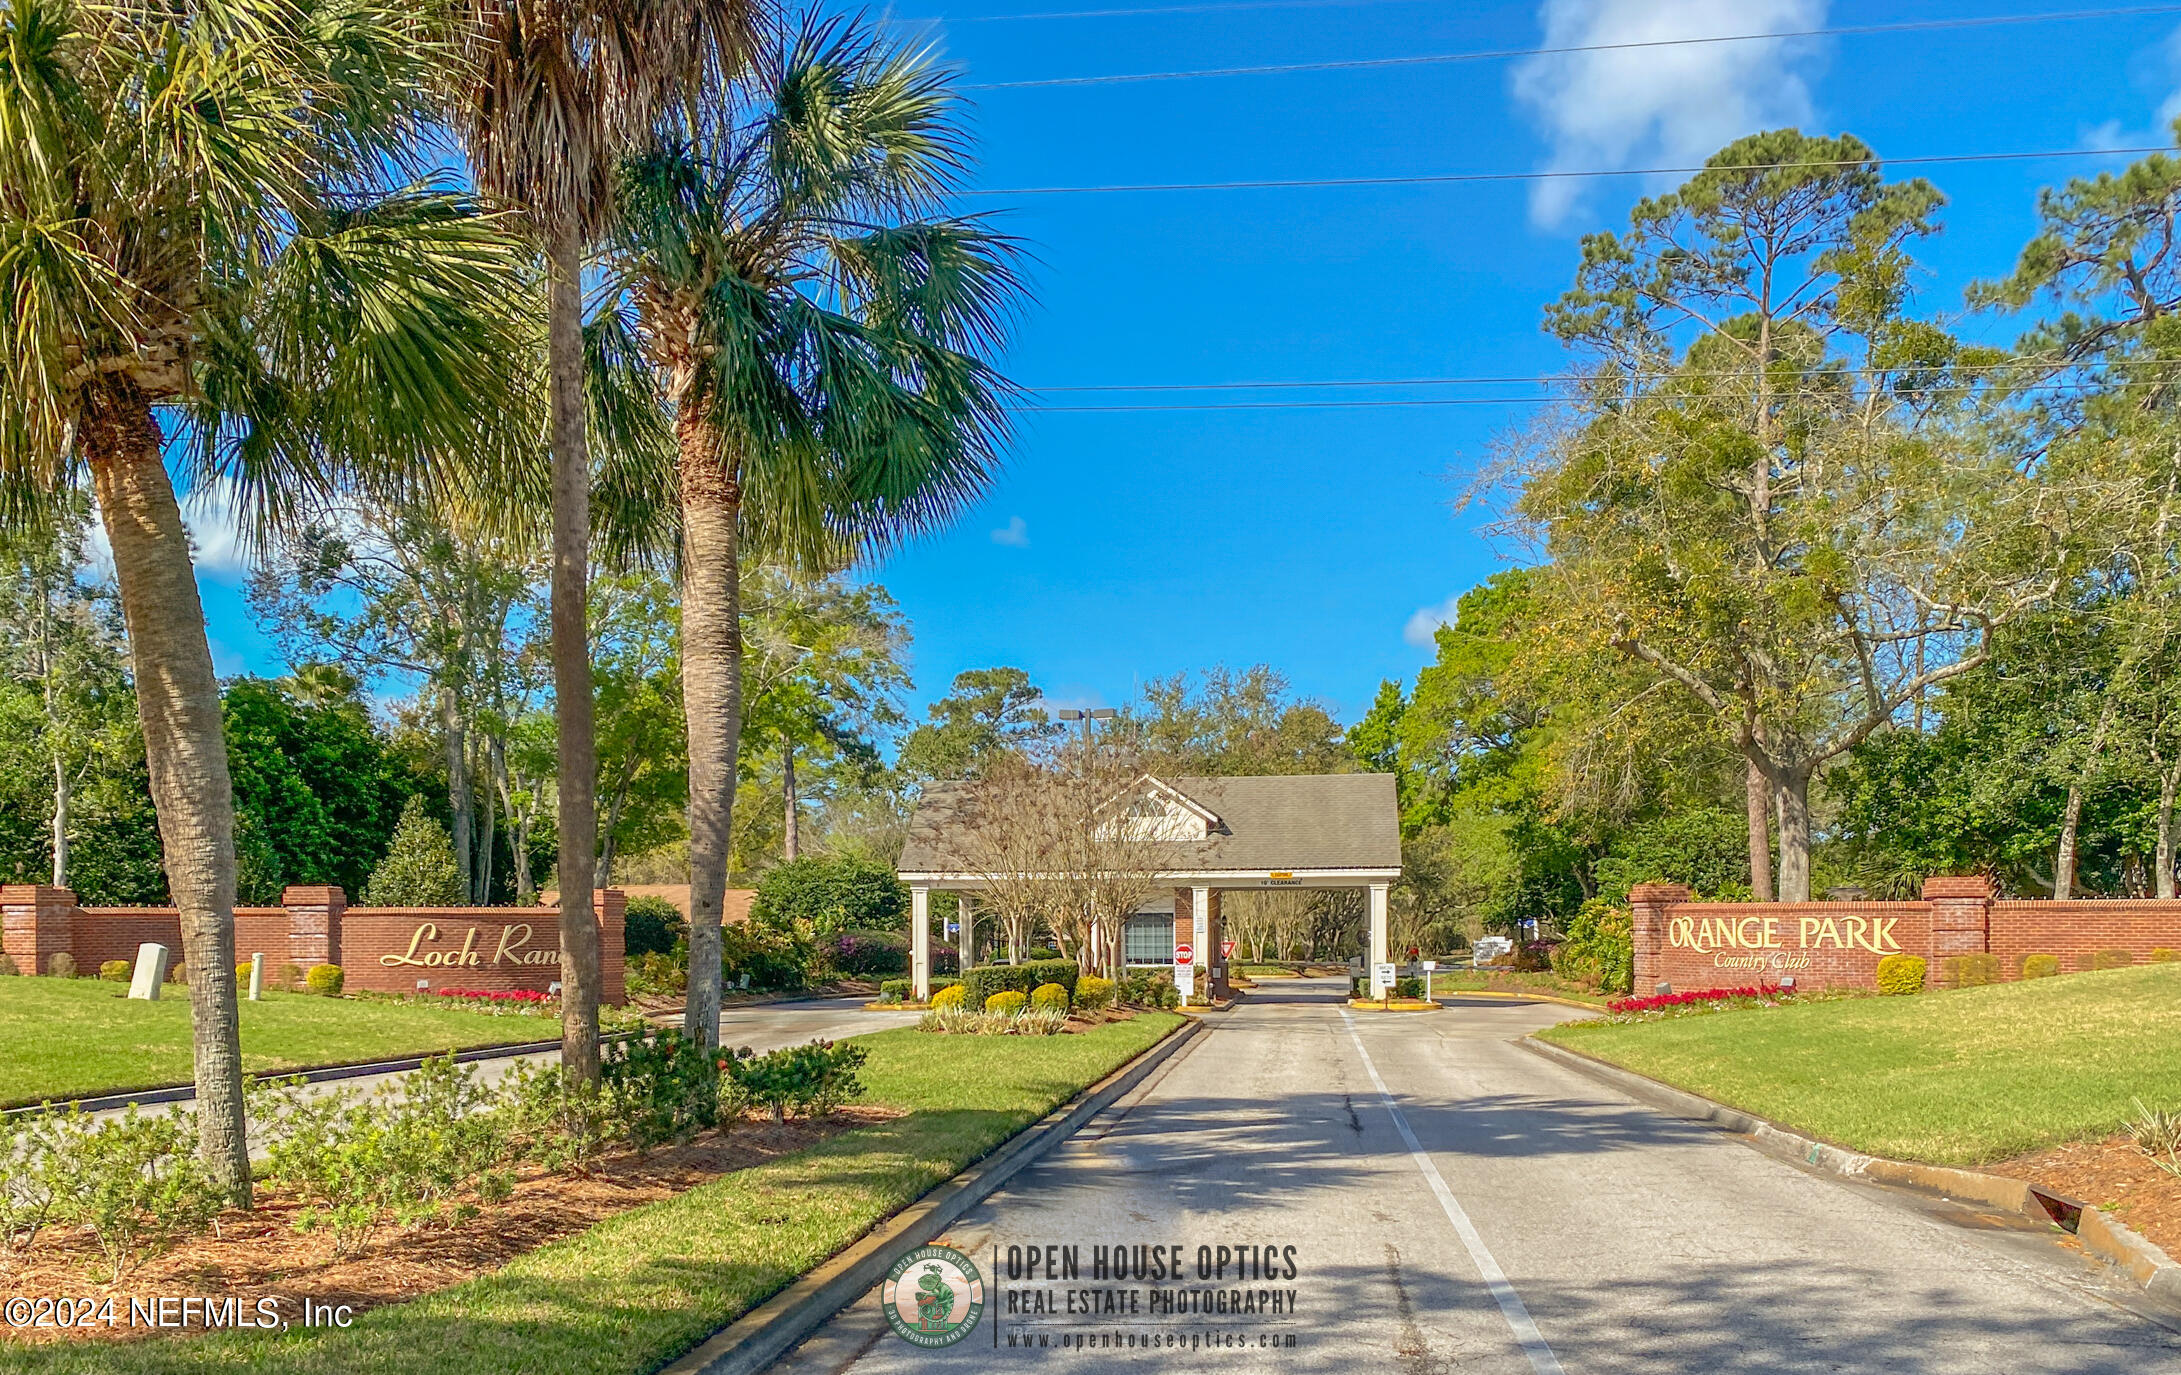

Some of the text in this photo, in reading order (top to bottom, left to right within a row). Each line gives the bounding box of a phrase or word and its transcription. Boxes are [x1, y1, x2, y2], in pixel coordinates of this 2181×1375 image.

[379, 922, 480, 967] Loch
[1669, 915, 1902, 956] ORANGE PARK
[1175, 951, 1193, 959] STOP
[1714, 951, 1811, 973] Country Club
